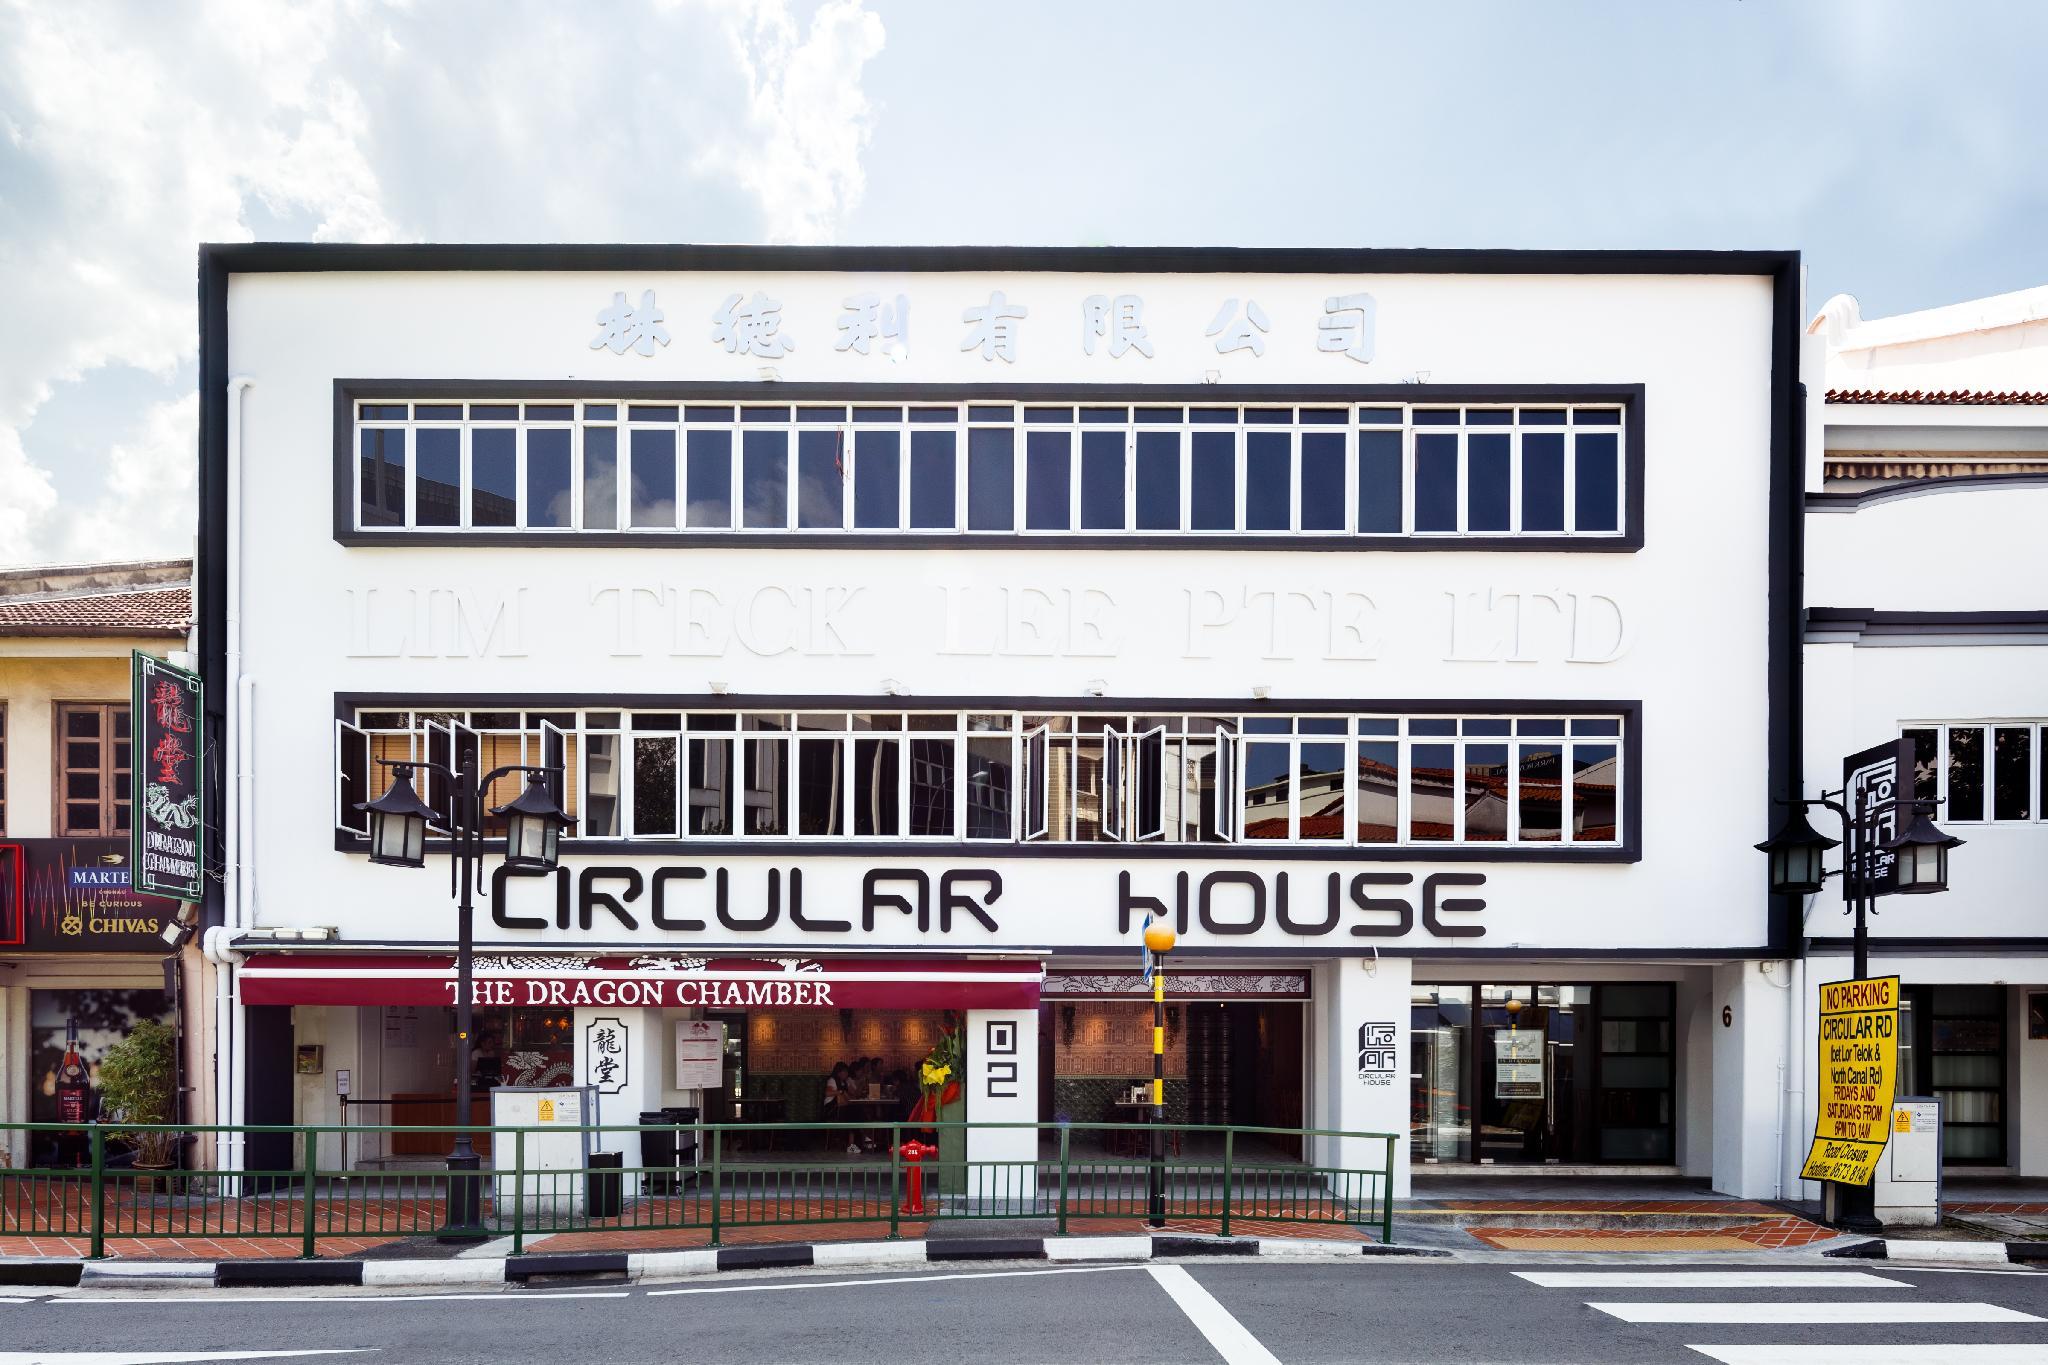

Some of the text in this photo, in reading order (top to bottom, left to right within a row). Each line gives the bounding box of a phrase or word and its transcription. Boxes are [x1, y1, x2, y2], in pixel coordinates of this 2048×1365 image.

[588, 288, 1378, 364] 林德利有限公司
[345, 582, 1638, 664] LIM TECK LEE PTE LTD
[82, 900, 143, 908] BE CURIOUS
[492, 866, 1487, 937] CIRCULAR HOUSE
[88, 918, 159, 934] CHIVAS
[445, 981, 834, 1006] THE DRAGON CHAMBER
[1826, 981, 1890, 1010] NO PARKING
[1722, 1005, 1732, 1028] 6
[1823, 1014, 1893, 1041] CIRCULAR RD
[593, 1028, 621, 1083] 龍堂
[1853, 1043, 1873, 1062] Telok
[1874, 1042, 1881, 1062] &
[1830, 1065, 1882, 1089] North Canal Rd)
[1833, 1085, 1876, 1101] FRIDAYS AND
[1827, 1102, 1883, 1121] SATURDAYS FROM
[1847, 1121, 1857, 1138] TO
